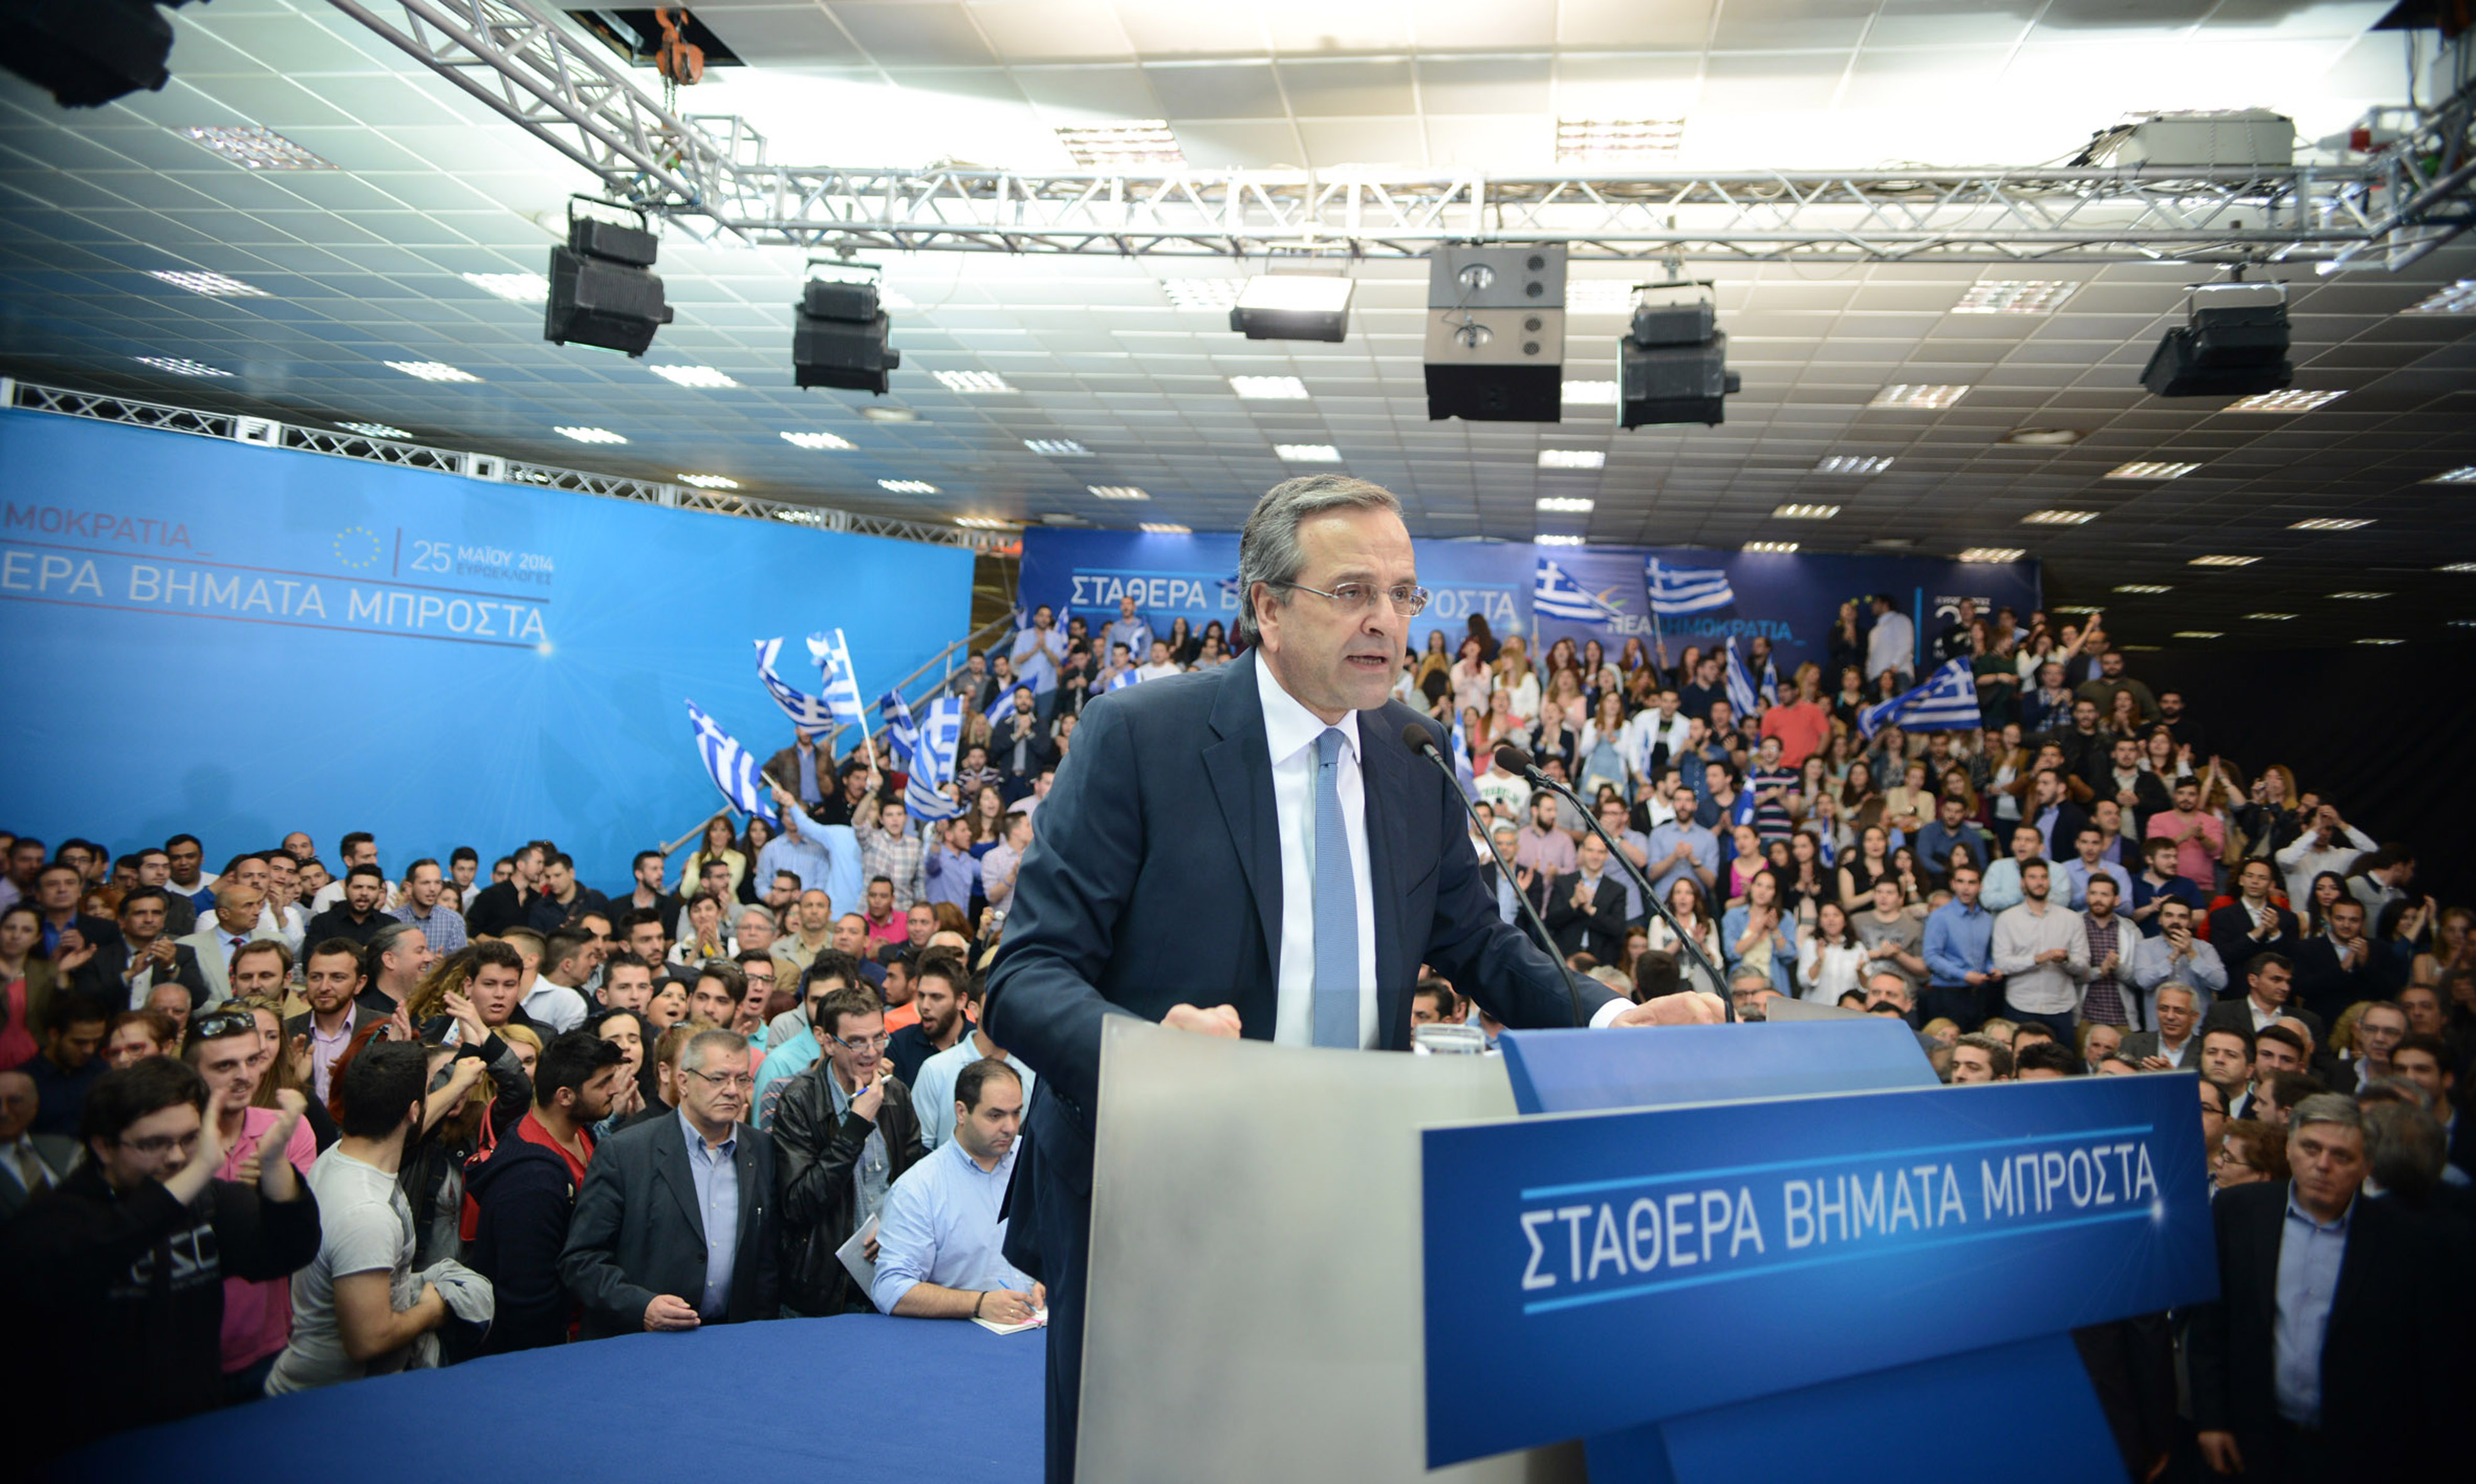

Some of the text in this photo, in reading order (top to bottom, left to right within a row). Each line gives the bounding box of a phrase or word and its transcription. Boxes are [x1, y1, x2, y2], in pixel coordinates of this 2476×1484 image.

[0, 501, 192, 549] ΜΟΚΡΑΤΙΑ
[410, 540, 554, 572] 25 ΜΑΪΟΥ 2014
[1, 550, 547, 640] ΕΡΑ ΒΗΜΑΤΑ ΜΠΡΟΣΤΑ
[1070, 576, 1207, 608] ΣΤΑΘΕΡΑ
[1520, 1142, 2158, 1290] ΣΤΑΘΕΡΑ ΒΗΜΑΤΑ ΜΠΡΟΣΤΑ
